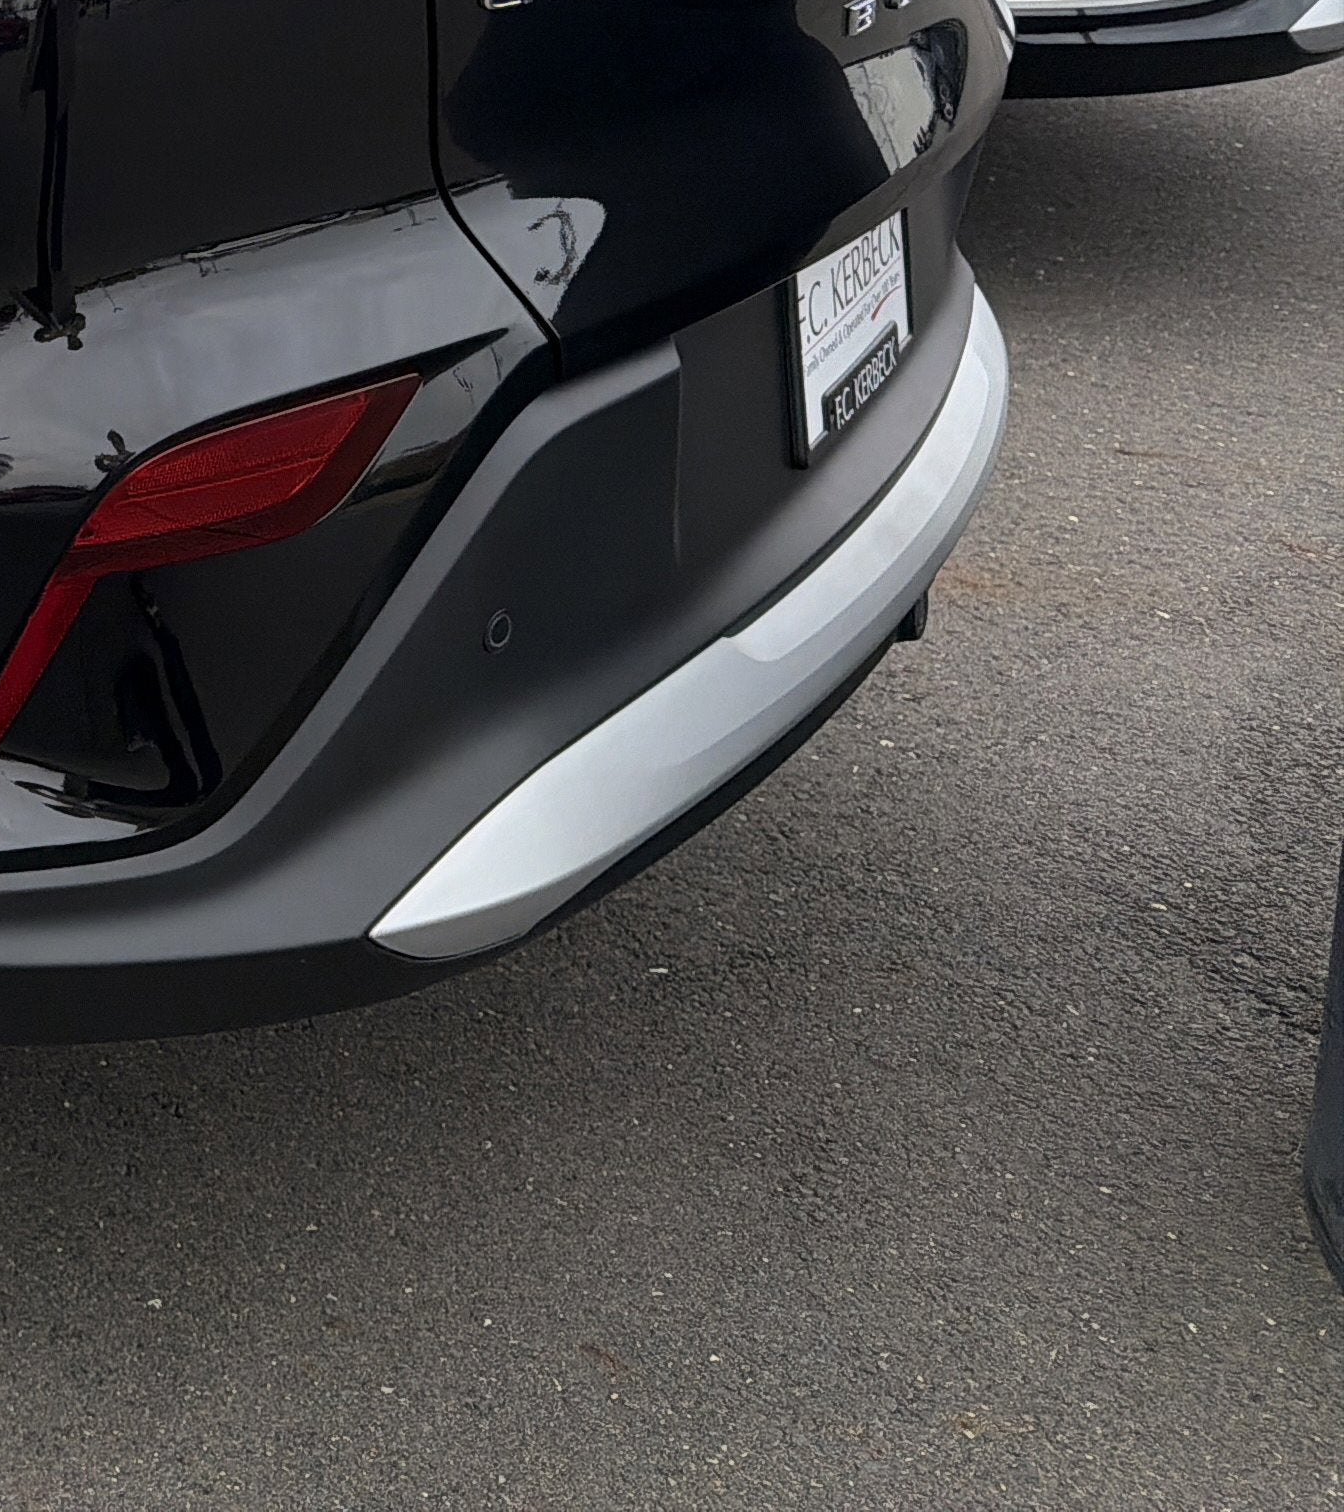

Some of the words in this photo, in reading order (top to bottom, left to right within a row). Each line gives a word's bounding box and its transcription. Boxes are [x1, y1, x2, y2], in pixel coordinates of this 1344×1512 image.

[830, 215, 900, 318] KERBECK
[834, 387, 854, 430] F.C.
[853, 336, 897, 409] KERBECK
